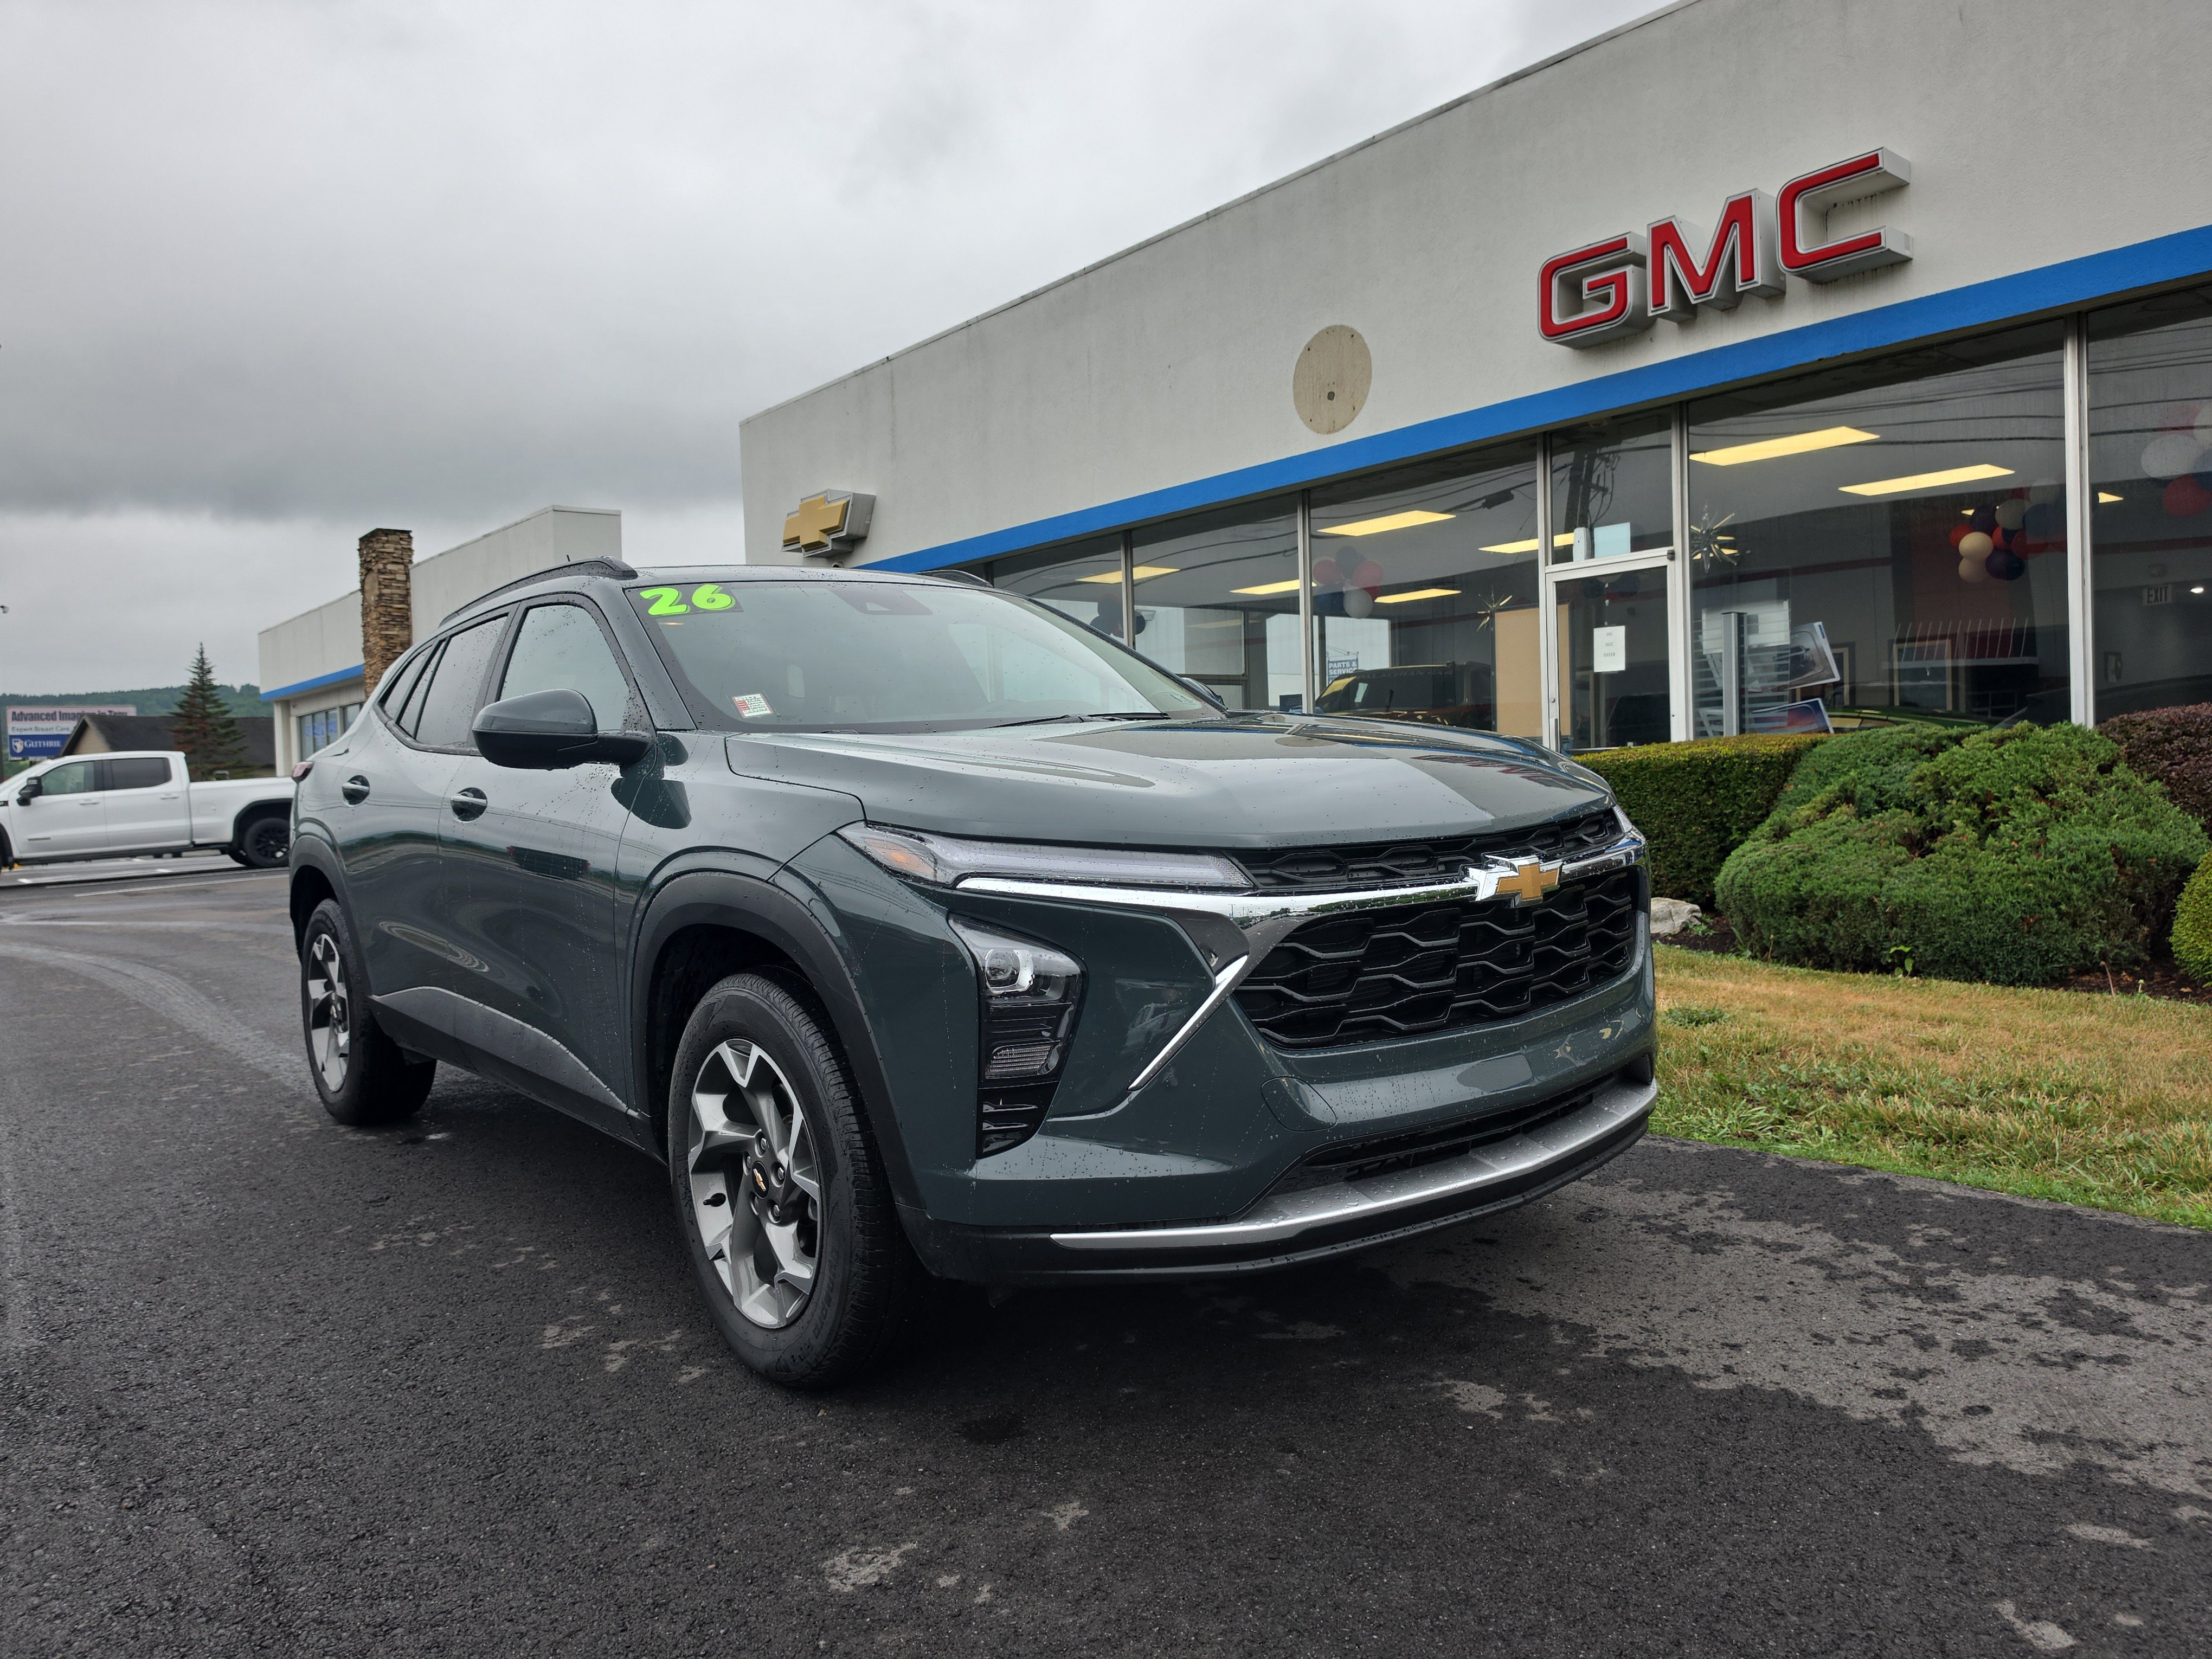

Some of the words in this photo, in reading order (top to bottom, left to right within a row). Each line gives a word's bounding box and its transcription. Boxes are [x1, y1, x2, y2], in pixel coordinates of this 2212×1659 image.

[1538, 146, 1912, 347] GMC
[640, 583, 736, 616] 26
[2147, 586, 2169, 604] EXIT
[11, 711, 57, 722] Advanced
[24, 740, 62, 748] GUTHRIE
